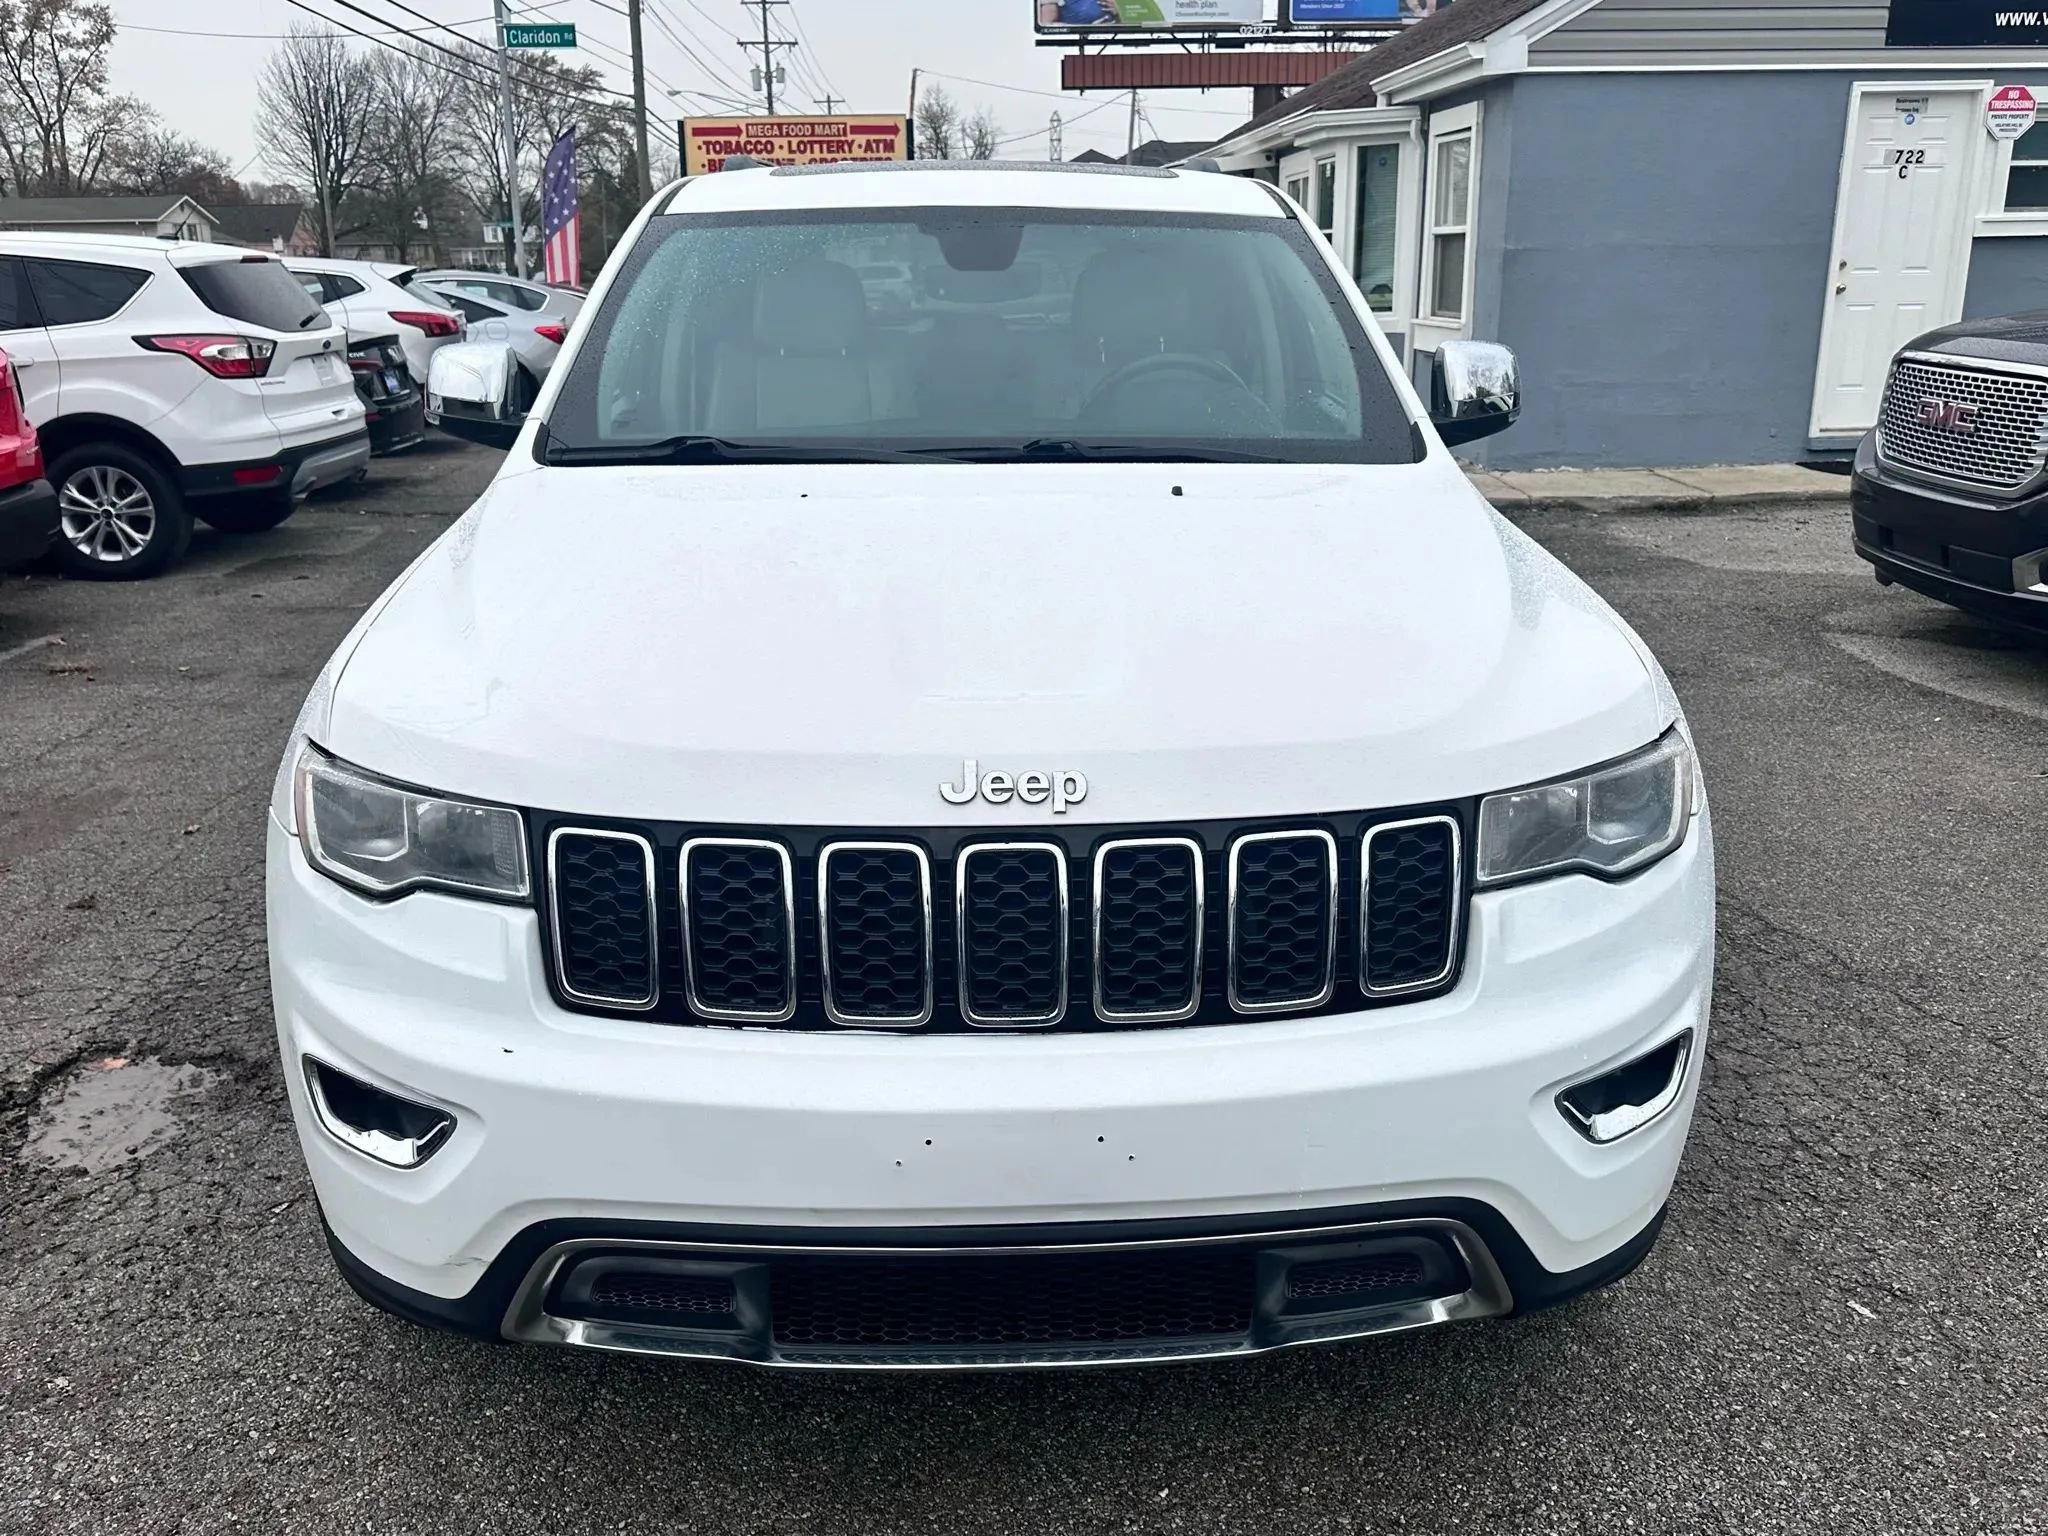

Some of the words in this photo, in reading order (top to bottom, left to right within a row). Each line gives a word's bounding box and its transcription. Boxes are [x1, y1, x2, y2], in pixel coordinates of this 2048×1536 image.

[509, 30, 561, 44] Claridon
[2007, 90, 2020, 99] NO
[1991, 100, 2034, 109] TRESPASSING
[748, 124, 780, 136] MEGA
[782, 124, 812, 136] FOOD
[814, 124, 845, 136] MART
[702, 140, 775, 155] TOBACCO
[787, 139, 856, 154] LOTTERY
[863, 138, 895, 153] ATM
[1894, 150, 1925, 164] 722
[1898, 165, 1909, 179] C
[1916, 398, 1978, 432] GMC
[939, 759, 1088, 814] Jeep
